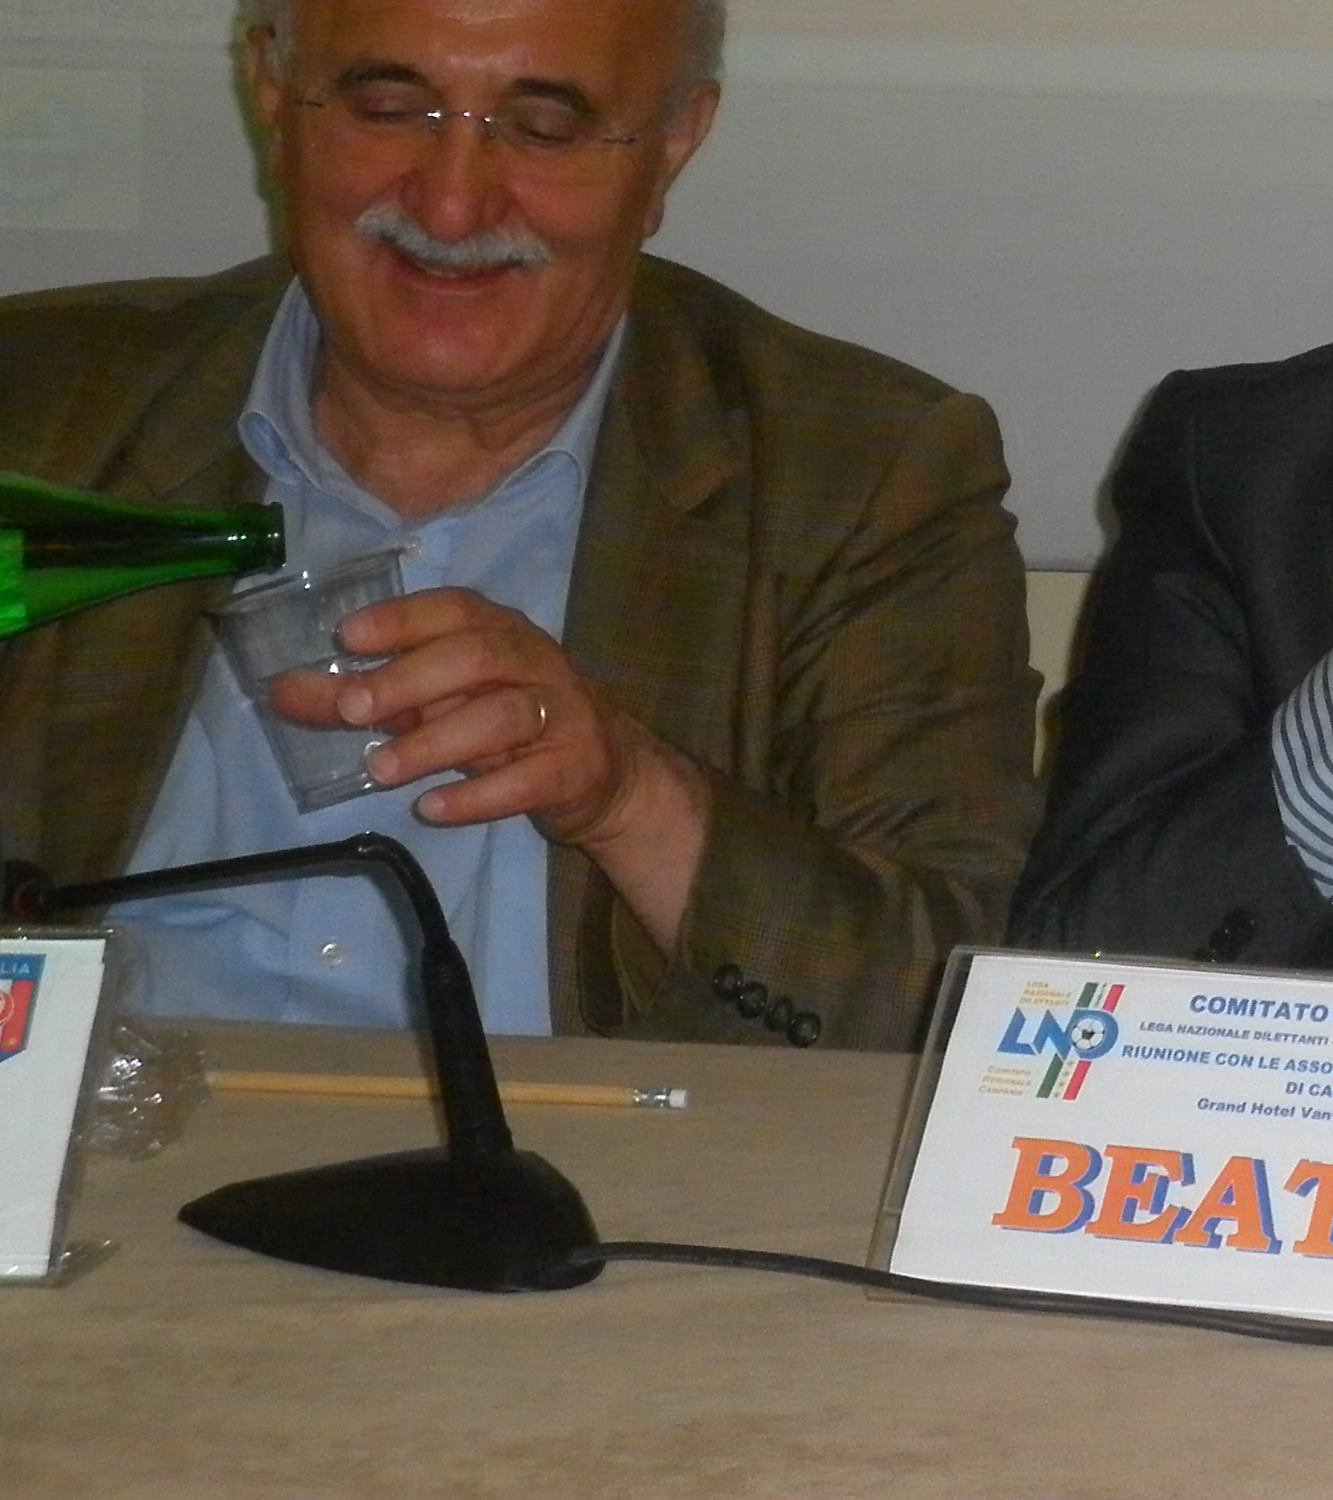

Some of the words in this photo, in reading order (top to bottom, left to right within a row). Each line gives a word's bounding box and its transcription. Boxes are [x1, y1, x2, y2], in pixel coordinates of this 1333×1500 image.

[1189, 994, 1329, 1022] COMITATO
[996, 1005, 1120, 1063] LND
[1139, 1021, 1173, 1034] LEGA
[1176, 1024, 1251, 1040] NAZIONALE
[1253, 1030, 1329, 1046] DILETTANTI
[1121, 1044, 1211, 1065] RIUNIONE
[1214, 1052, 1253, 1068] CON
[1257, 1056, 1280, 1070] LE
[1285, 1081, 1305, 1095] DI
[1196, 1097, 1246, 1114] Grand
[1250, 1102, 1296, 1118] Hotel
